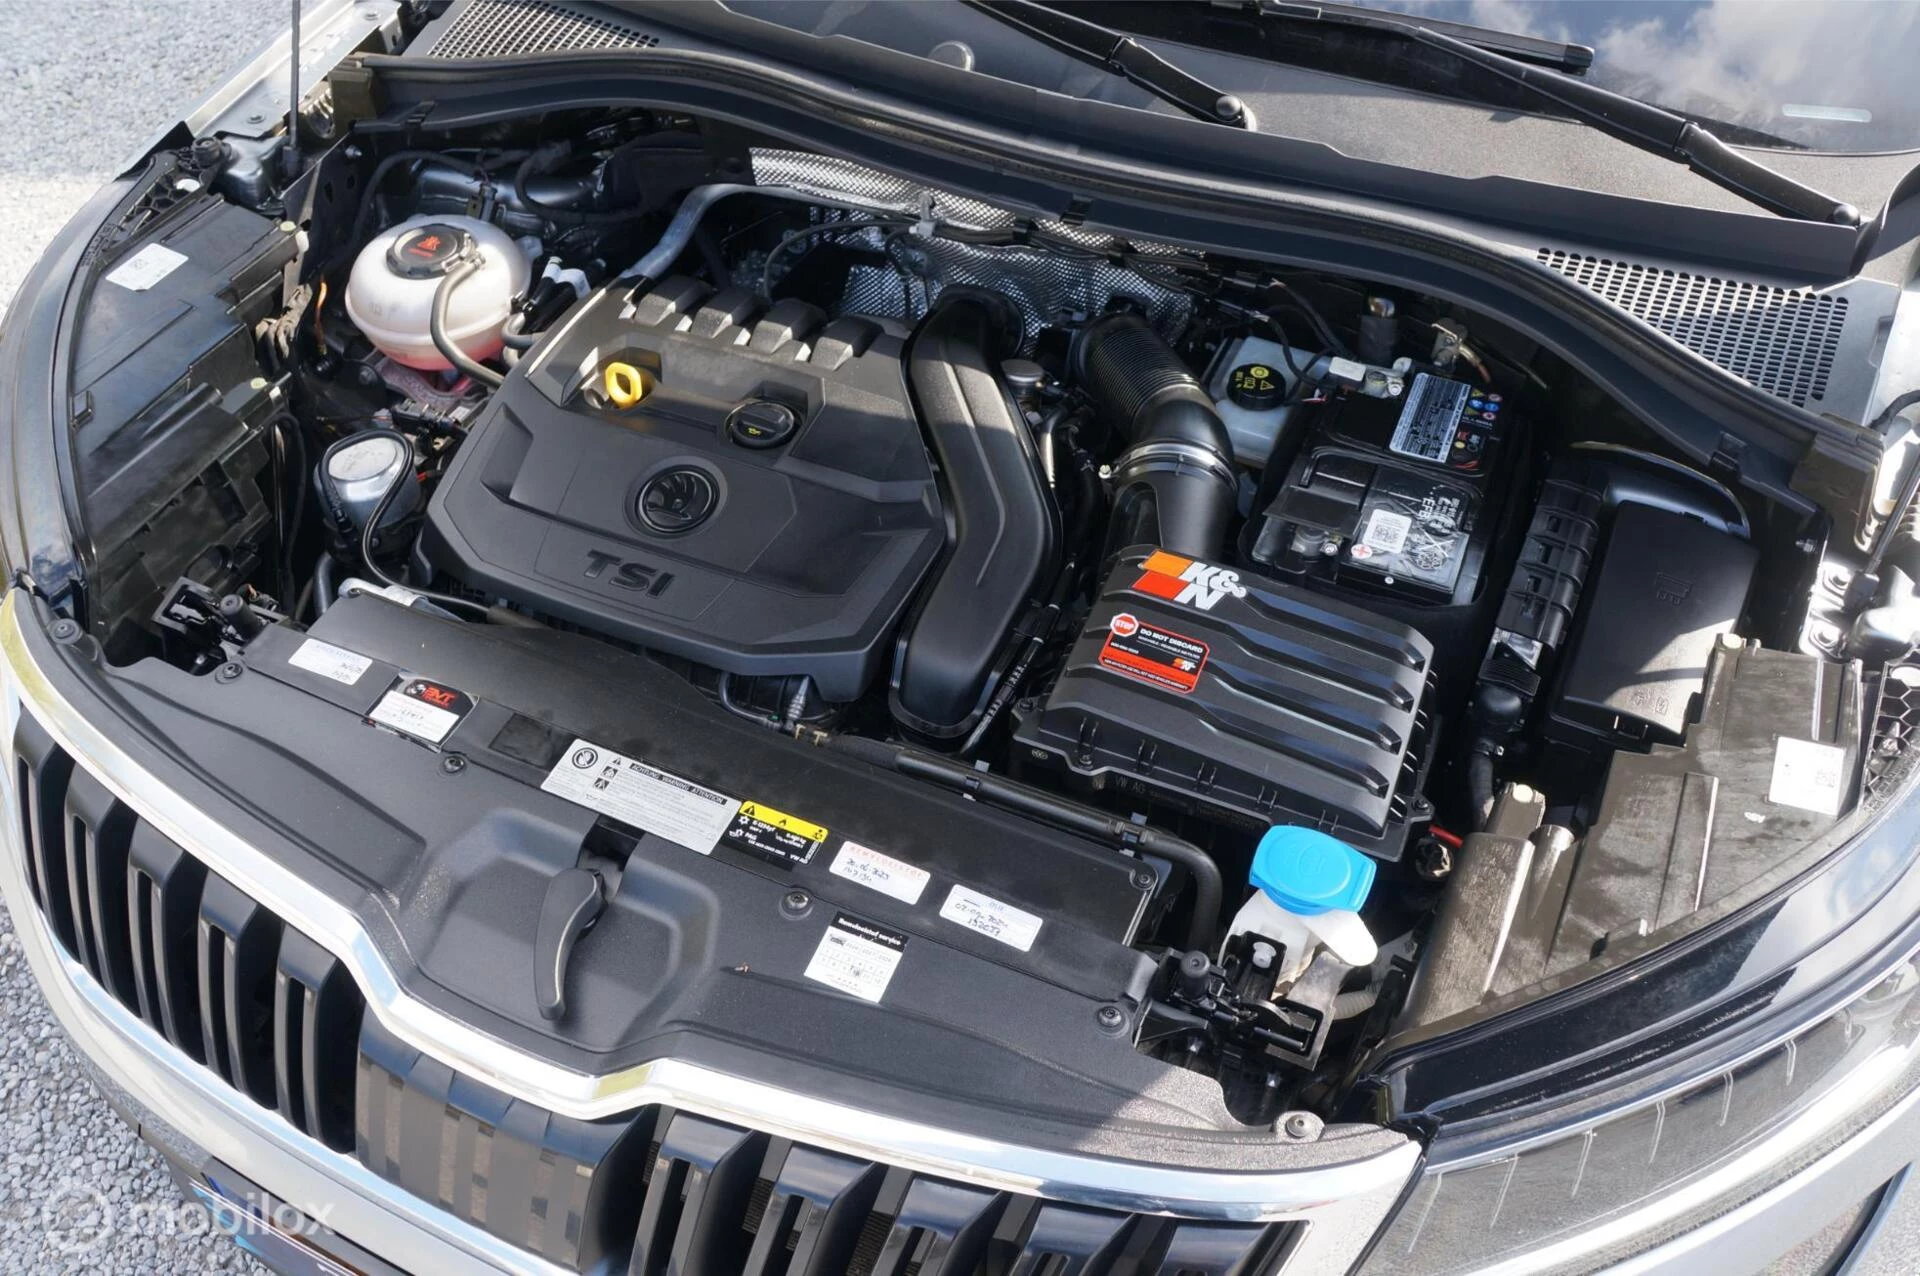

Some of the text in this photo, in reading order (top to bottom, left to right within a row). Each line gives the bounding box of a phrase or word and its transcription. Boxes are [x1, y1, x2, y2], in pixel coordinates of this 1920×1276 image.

[584, 549, 676, 599] TSI
[1173, 561, 1247, 610] K&N
[1114, 619, 1135, 631] STOP
[1140, 628, 1152, 636] DO
[1152, 632, 1169, 642] NOT
[1169, 638, 1203, 653] DISCARD
[632, 764, 723, 804] ACHTUNG WARNING ATTENTION
